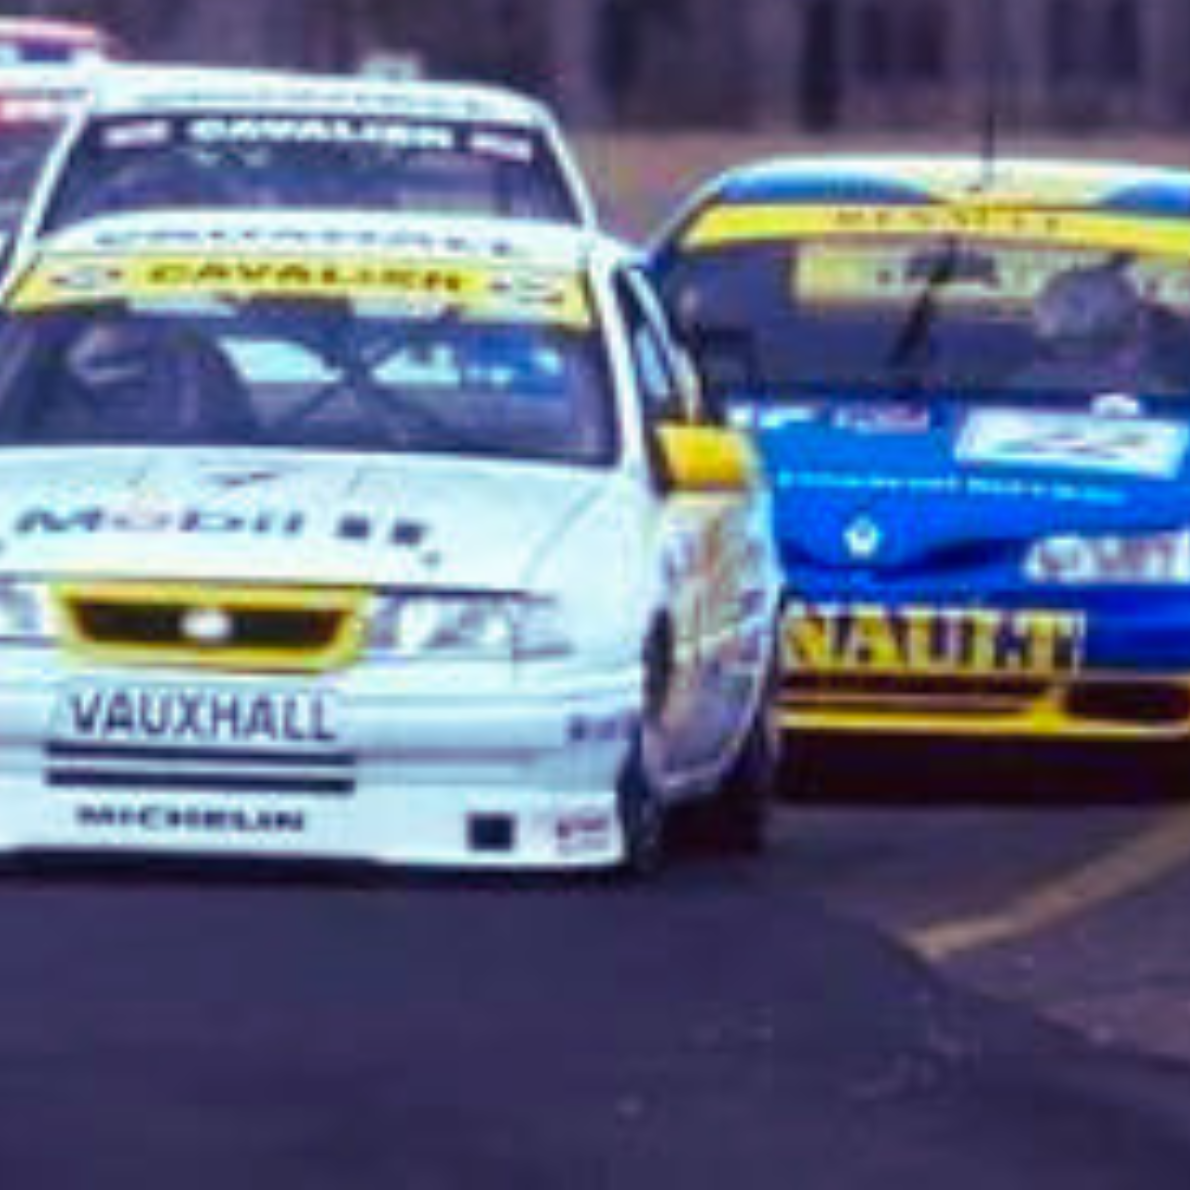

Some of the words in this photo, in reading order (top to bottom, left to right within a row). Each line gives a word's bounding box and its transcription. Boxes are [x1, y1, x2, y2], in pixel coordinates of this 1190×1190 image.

[188, 119, 455, 149] CAVALIER
[146, 262, 465, 292] CAVALIER
[72, 693, 336, 741] VAUXHALL
[75, 805, 306, 832] MICHELIN
